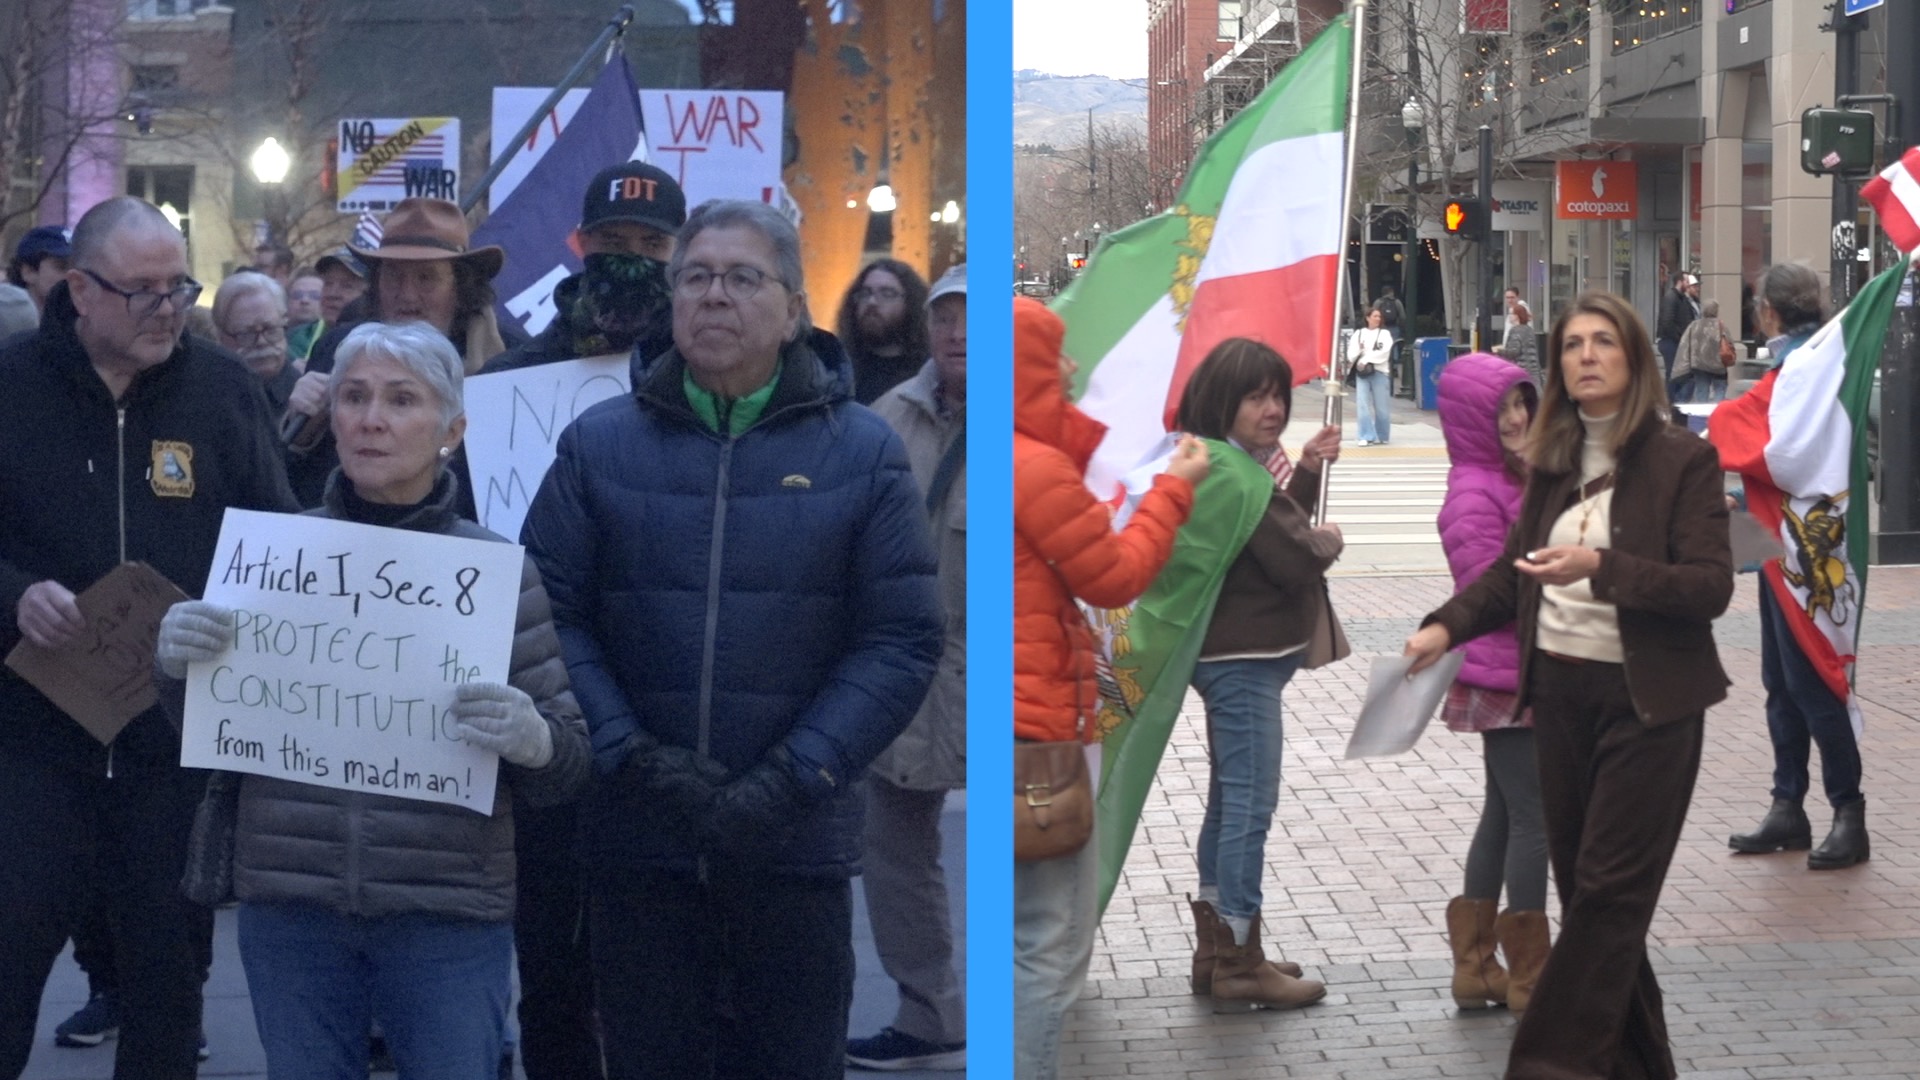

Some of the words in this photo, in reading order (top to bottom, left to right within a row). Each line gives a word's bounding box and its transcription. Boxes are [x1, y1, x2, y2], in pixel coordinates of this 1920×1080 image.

[342, 121, 375, 154] NO
[360, 120, 424, 176] CAUTION
[664, 94, 763, 153] WAR
[403, 165, 456, 200] WAR
[609, 177, 658, 202] FDT
[1499, 200, 1538, 211] NTASTIC
[1567, 201, 1630, 216] cotopaxi
[222, 538, 317, 596] Article
[369, 560, 442, 607] Sec.
[455, 567, 481, 616] 8
[231, 609, 416, 673] PROTECT
[438, 644, 481, 685] the
[210, 665, 471, 746] CONSTITUTIO
[214, 719, 264, 761] from
[278, 733, 329, 777] this
[344, 757, 471, 799] madman!
